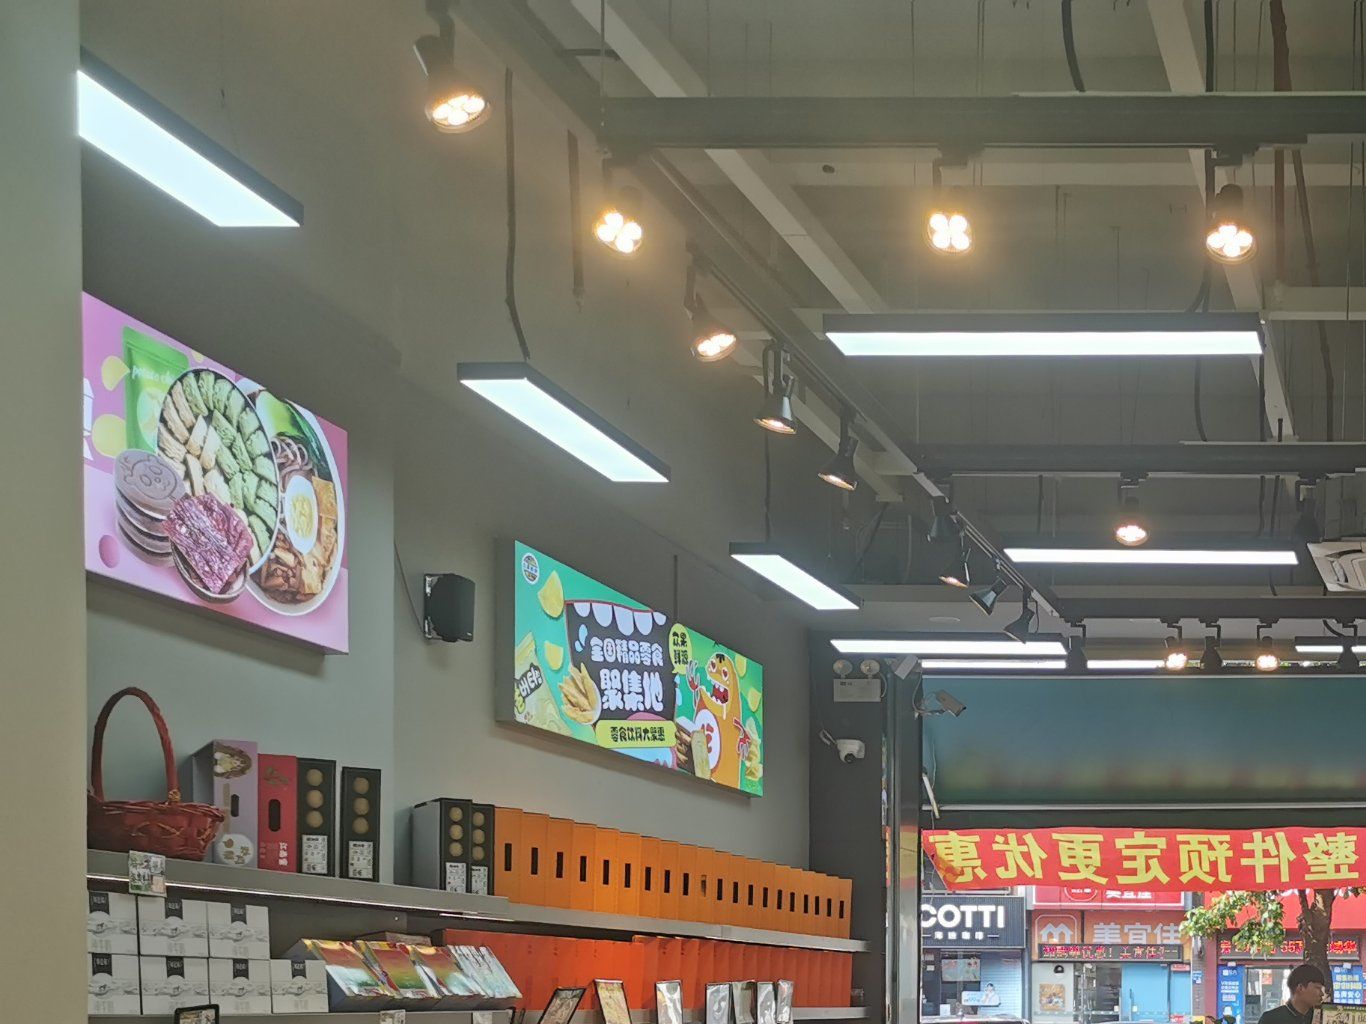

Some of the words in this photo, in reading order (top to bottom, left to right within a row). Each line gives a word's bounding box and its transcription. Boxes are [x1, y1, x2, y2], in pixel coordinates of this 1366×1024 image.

[590, 637, 664, 667] 全国精品零食
[600, 668, 664, 712] 聚集地
[920, 904, 1005, 928] COTTI
